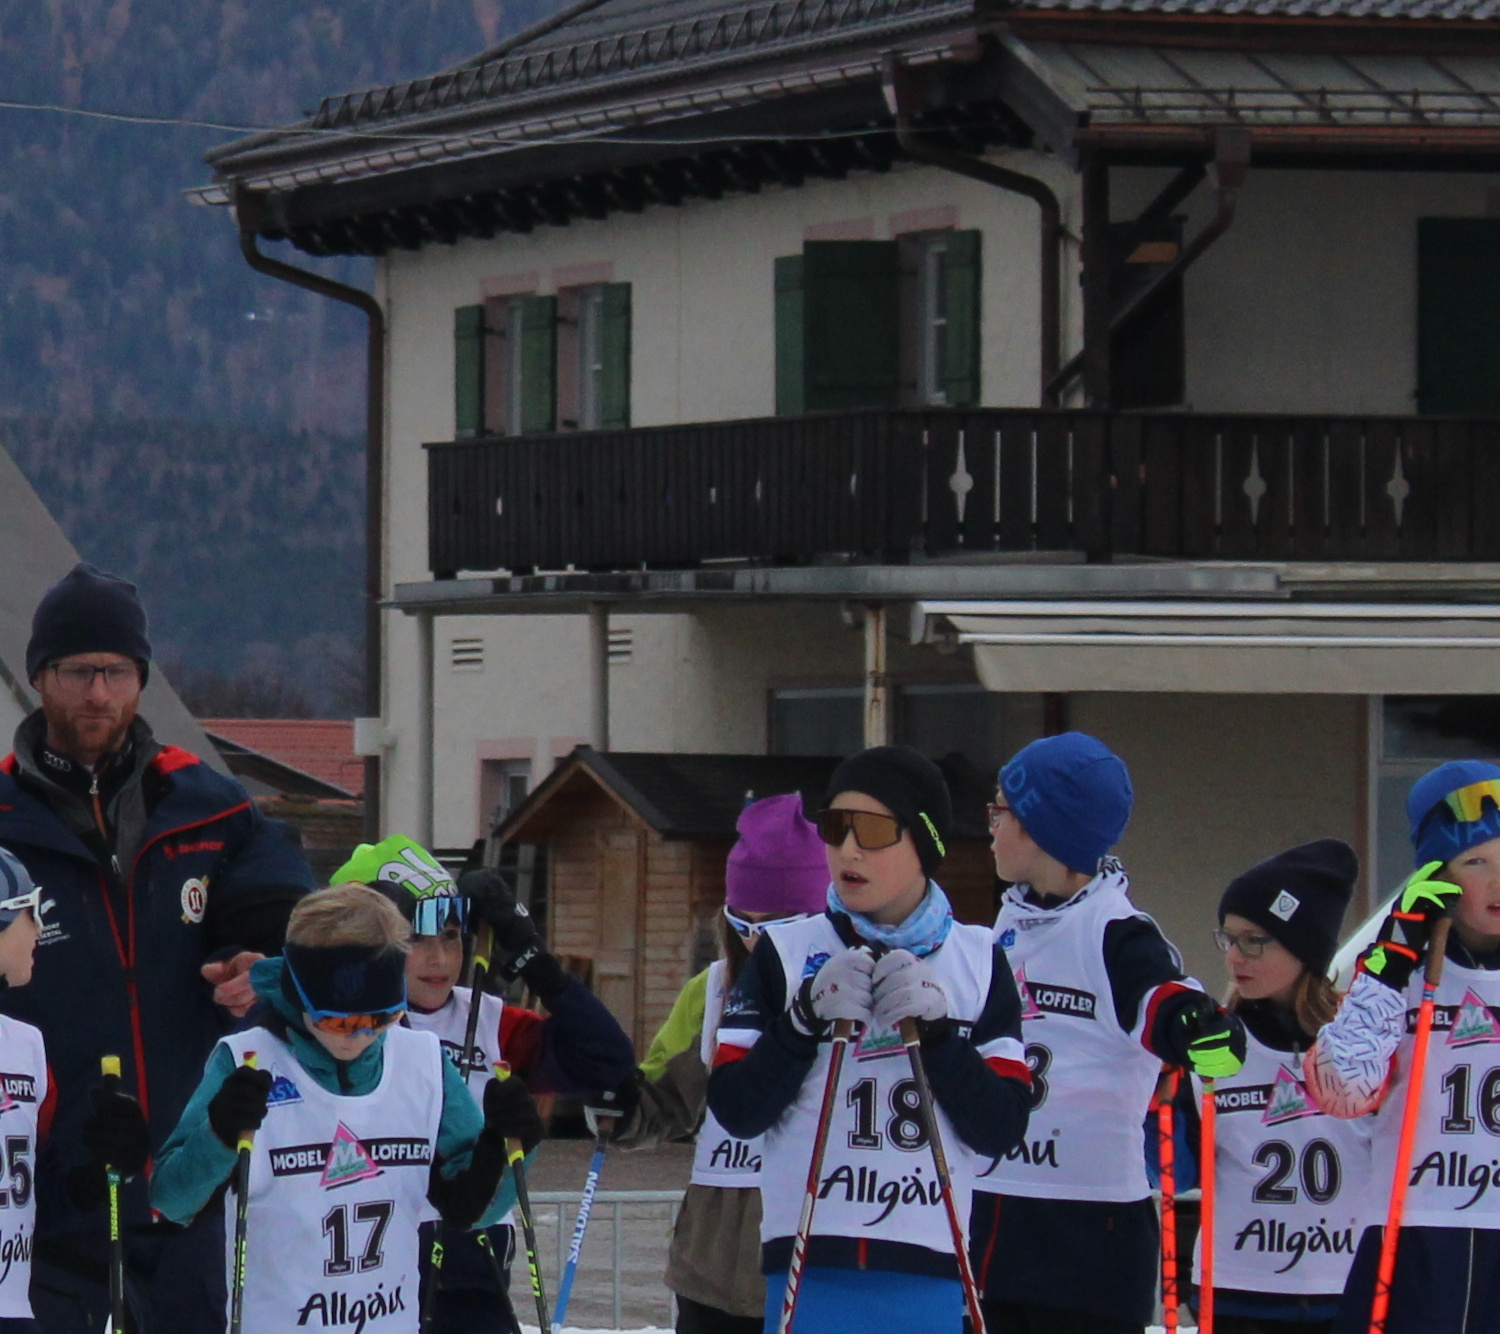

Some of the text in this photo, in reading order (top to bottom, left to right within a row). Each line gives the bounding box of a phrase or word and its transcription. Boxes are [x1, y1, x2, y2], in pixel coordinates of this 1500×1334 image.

[509, 946, 540, 974] LEKI
[1034, 987, 1095, 1014] LÖFFLER
[847, 1077, 933, 1153] 18
[272, 1142, 432, 1171] MÖBEL LÖFFLER
[1251, 1138, 1342, 1205] 20
[321, 1199, 395, 1277] 17
[568, 1169, 599, 1266] SALOMON
[1233, 1218, 1356, 1274] Allgäu
